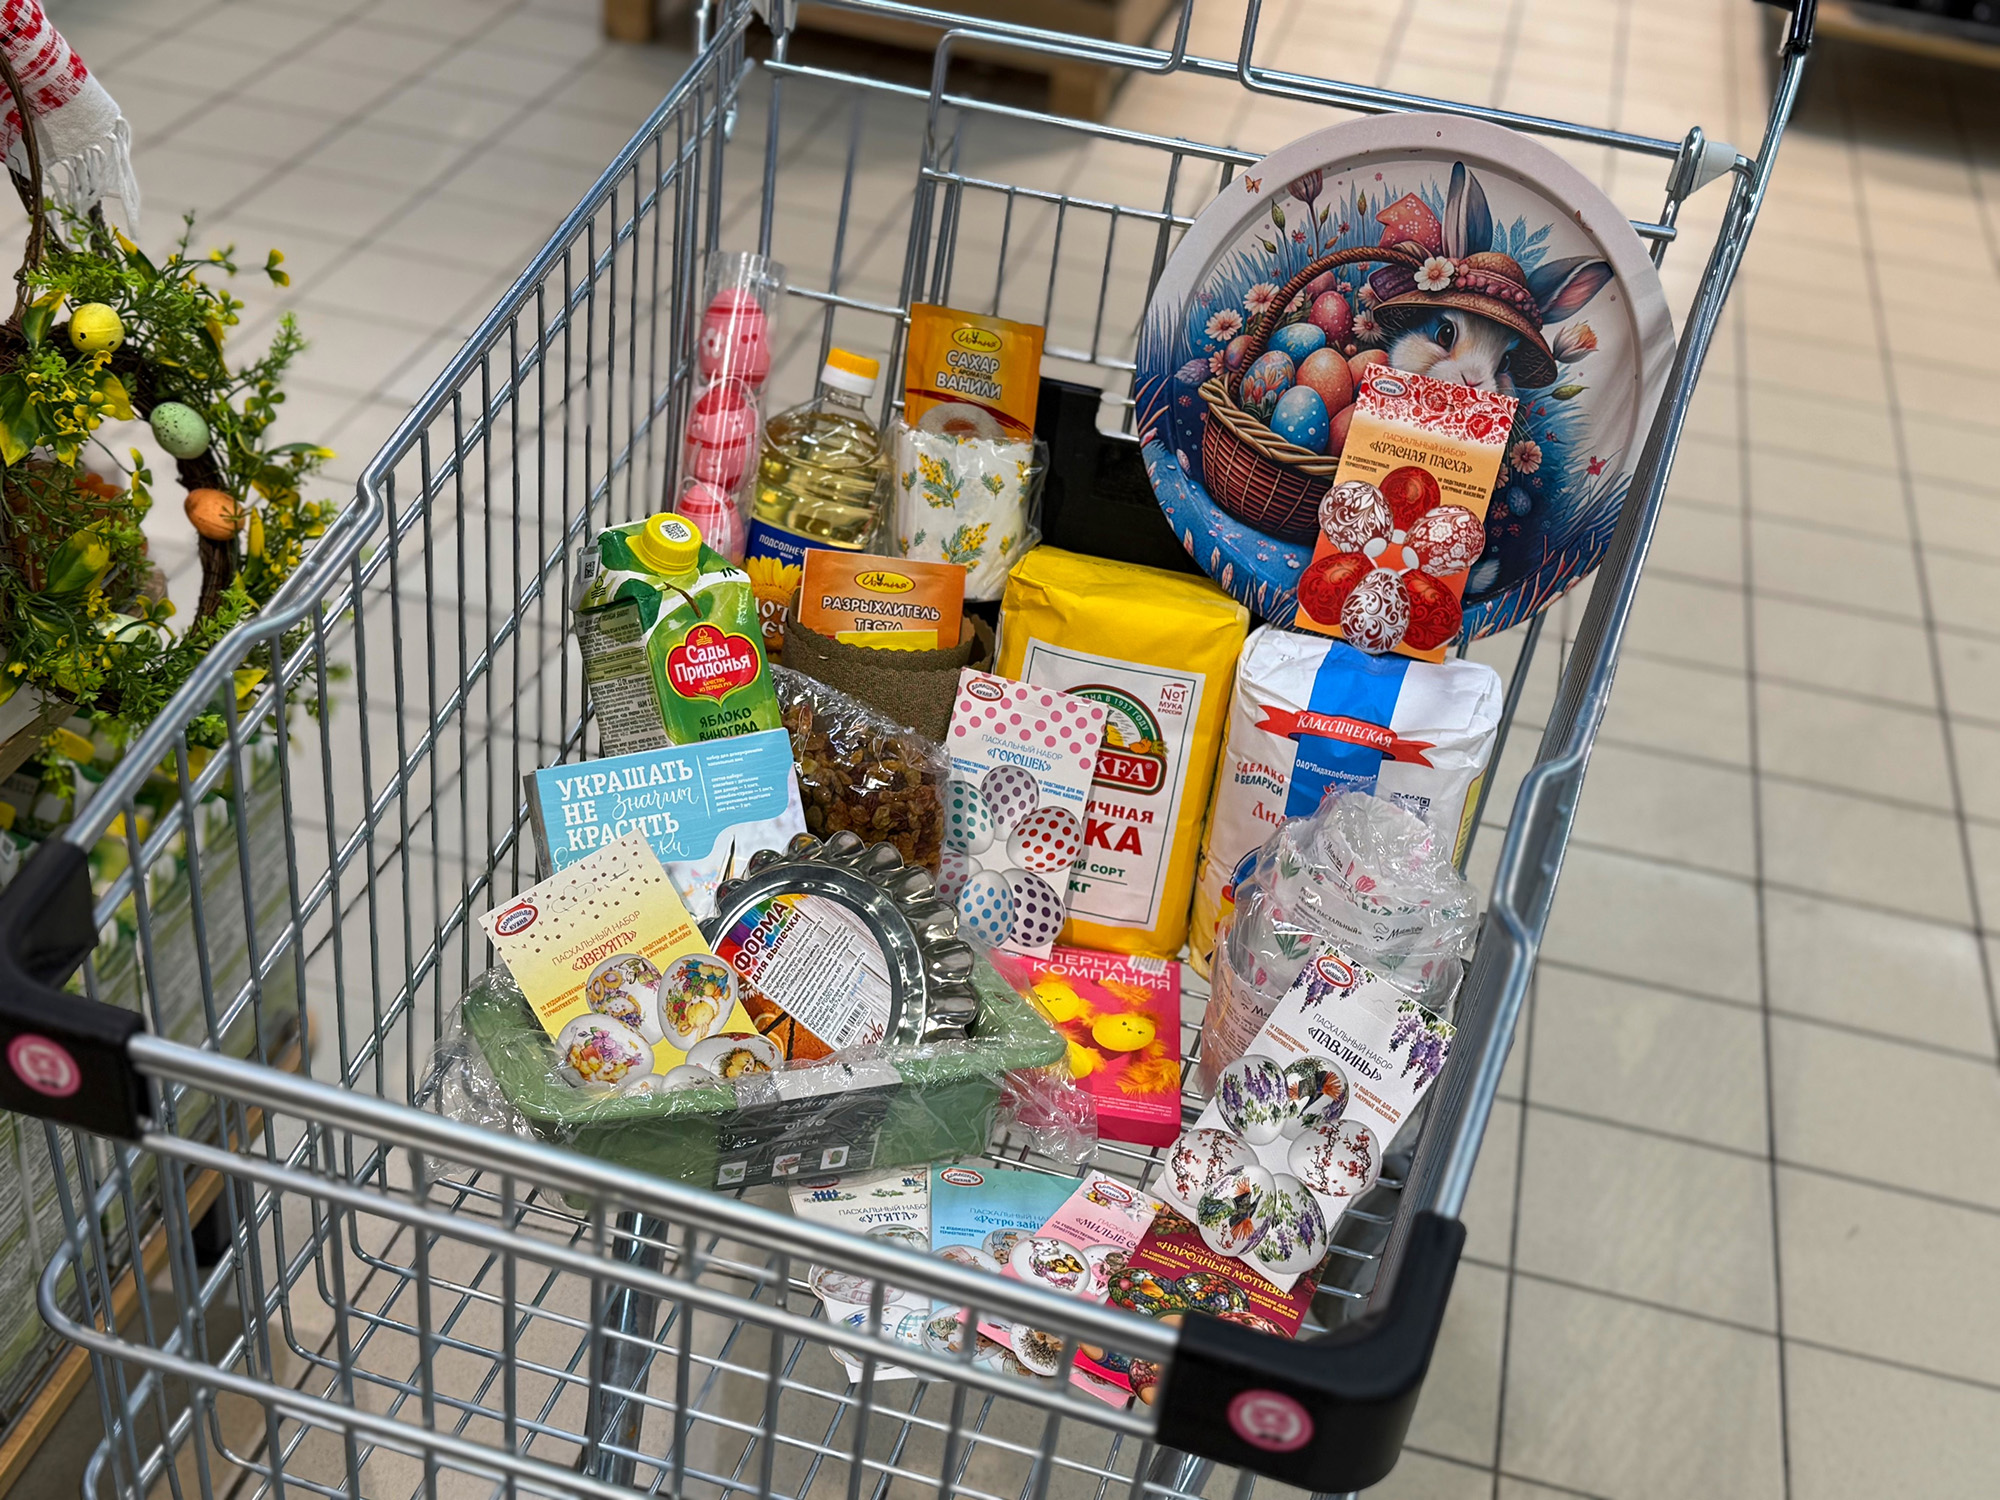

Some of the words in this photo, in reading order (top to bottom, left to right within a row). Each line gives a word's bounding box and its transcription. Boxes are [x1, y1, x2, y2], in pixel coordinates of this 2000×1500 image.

[946, 351, 1000, 374] САХАР
[935, 371, 1002, 400] ВАНИЛИ
[1382, 432, 1439, 452] ПАСХАЛЬНЫЙ
[1439, 445, 1466, 457] НАБОР
[822, 596, 941, 620] РАЗРЫХЛИТЕЛЬ
[686, 644, 730, 663] Сады
[674, 654, 751, 685] Придонья
[700, 707, 751, 727] ЯБЛОКО
[1114, 698, 1132, 713] 1937
[1132, 711, 1150, 731] ГОДУ
[1159, 701, 1183, 710] МУКА
[699, 721, 759, 741] ВИНОГРАД
[1297, 715, 1392, 748] КЛАССИЧЕСКАЯ
[982, 734, 1035, 756] ПАСХАЛЬНЫЙ
[1036, 750, 1063, 760] НАБОР
[987, 748, 1052, 771] «ГОРОШЕК»
[555, 759, 693, 801] УКРАШАТЬ
[1236, 761, 1285, 784] СДЕЛАНО
[1240, 774, 1283, 797] БЕЛАРУСИ
[561, 800, 598, 826] НЕ
[566, 812, 679, 851] КРАСИТЬ
[1090, 864, 1125, 877] СОРТ
[552, 927, 612, 966] ПАСХАЛЬНЫЙ
[613, 910, 641, 934] НАБОР
[734, 902, 789, 971] ФОРМА
[752, 961, 768, 984] для
[766, 912, 801, 961] выпечки
[572, 930, 637, 972] «ЗВЕРЯТА»
[1033, 962, 1170, 991] КОМПАНИЯ
[1307, 1026, 1382, 1081] «ПАВЛИНЫ»
[1313, 1013, 1366, 1052] ПАСХАЛЬНЫЙ
[1365, 1047, 1393, 1070] НАБОР
[839, 1204, 900, 1216] ПАСХАЛЬНЫЙ
[859, 1212, 918, 1223] «УТЯТА»
[970, 1208, 1031, 1218] ПАСХАЛЬНЫЙ
[1155, 1241, 1232, 1275] «НАРОДНЫЕ
[1182, 1242, 1244, 1270] ПАСХАЛЬНЫЙ
